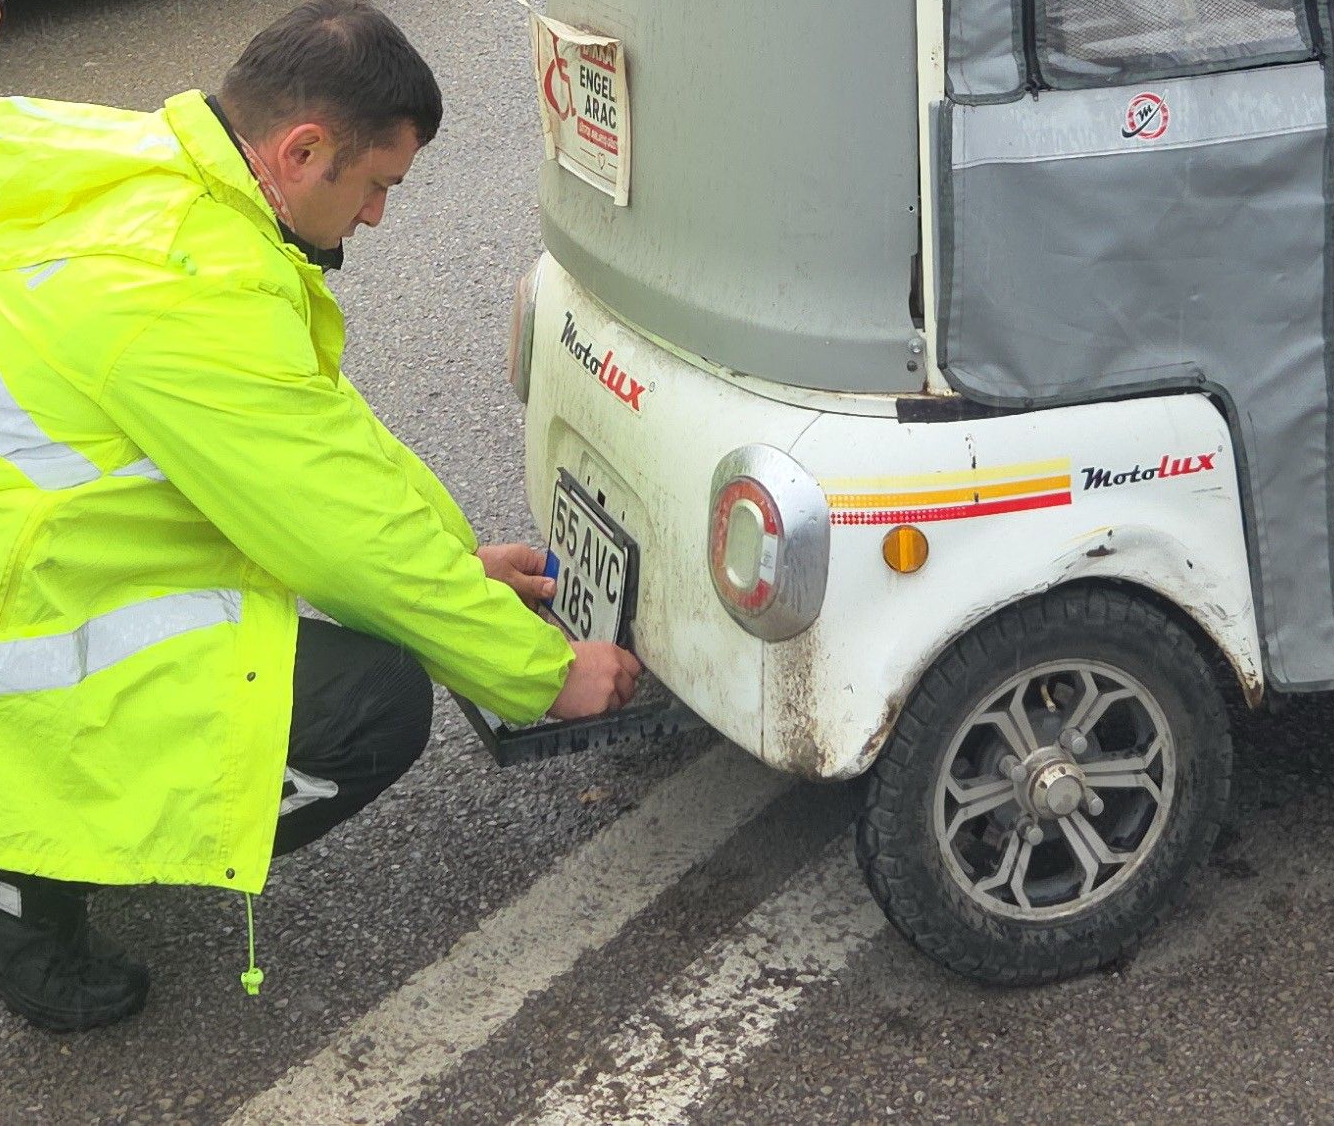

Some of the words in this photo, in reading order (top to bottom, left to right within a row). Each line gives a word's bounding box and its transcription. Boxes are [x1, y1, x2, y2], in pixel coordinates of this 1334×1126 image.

[555, 494, 580, 559] 55
[579, 526, 621, 605] AVC
[561, 566, 595, 640] 185
